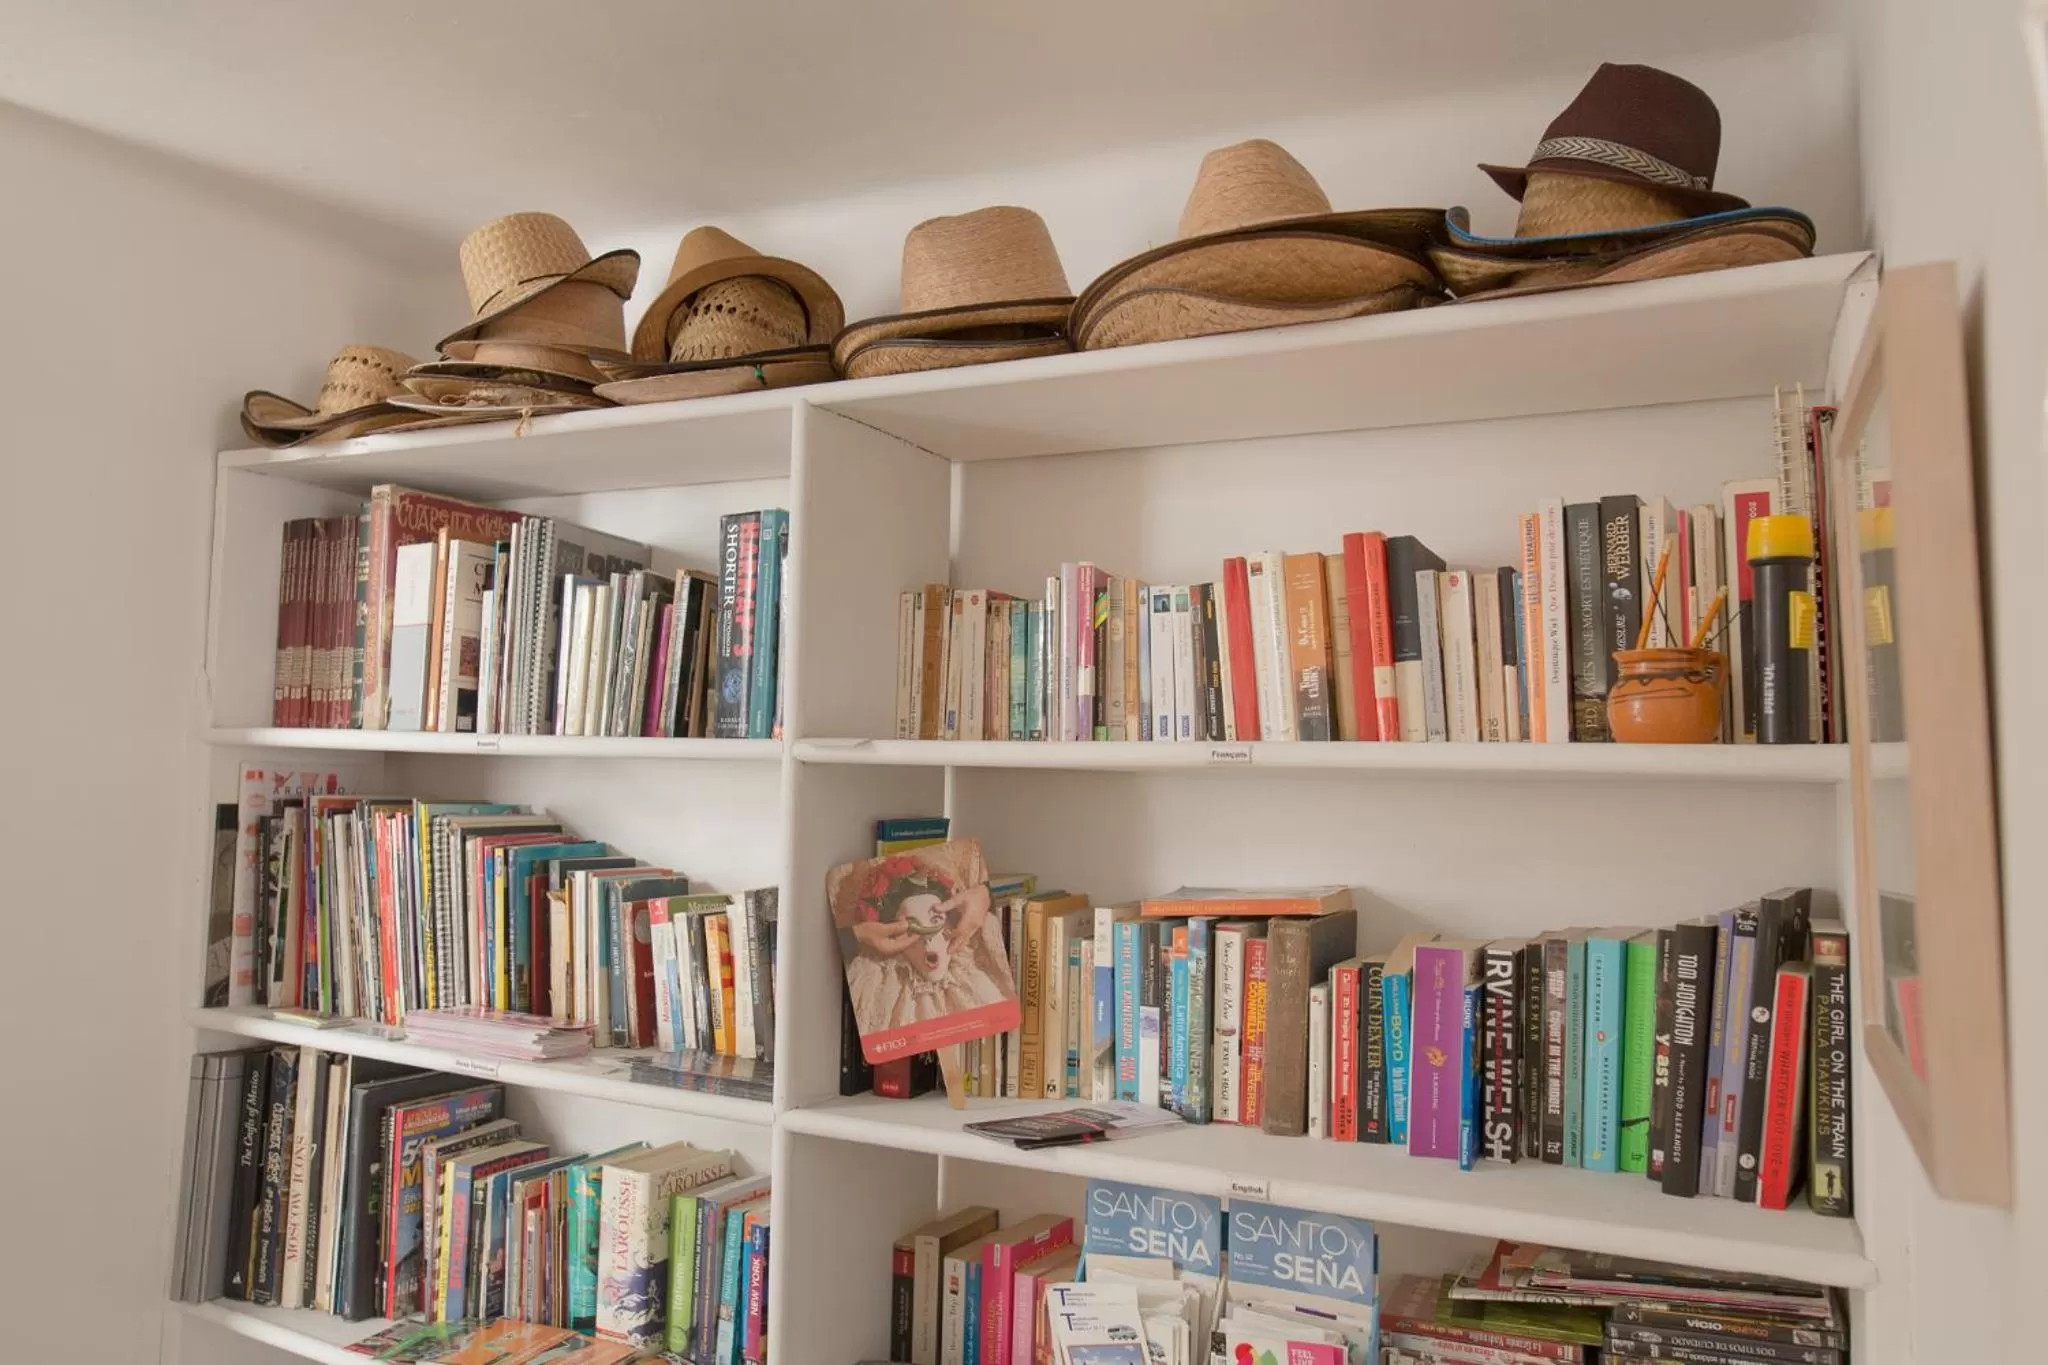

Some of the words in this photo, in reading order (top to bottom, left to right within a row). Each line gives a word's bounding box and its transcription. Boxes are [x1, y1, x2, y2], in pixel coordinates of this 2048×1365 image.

[723, 524, 737, 607] SHORTER
[1607, 522, 1617, 573] BERNARD
[1616, 514, 1630, 581] WERBER
[1581, 593, 1593, 628] MORT
[1582, 629, 1594, 656] UNE
[1583, 662, 1599, 701] JAMES
[1027, 939, 1039, 1008] FACUNDO
[1678, 954, 1697, 979] TOM
[1257, 981, 1267, 1034] MICHAEL
[1368, 967, 1382, 1011] COLIN
[1485, 949, 1513, 1051] IRVINE
[1531, 967, 1539, 1041] BLUESMAN
[1831, 974, 1844, 1004] THE
[1176, 1005, 1185, 1031] Latin
[1247, 981, 1257, 1042] CONNELLY
[1674, 983, 1696, 1046] HOUGHTON
[1817, 995, 1830, 1047] PAULA
[1831, 1009, 1845, 1042] GIRL
[1176, 1034, 1185, 1078] America
[1367, 1014, 1382, 1069] DEXTER
[1391, 1015, 1403, 1061] BOYD
[1548, 1057, 1561, 1076] THE
[1656, 1034, 1671, 1087] yeast
[1831, 1050, 1845, 1073] ON
[248, 1069, 260, 1106] Mexico
[1246, 1063, 1257, 1121] REVERSAL
[1548, 1077, 1560, 1115] MIDDLE
[1675, 1085, 1684, 1110] TODD
[1818, 1058, 1831, 1136] HAWKINS
[1831, 1078, 1845, 1108] THE
[243, 1119, 257, 1147] Crafts
[1483, 1059, 1513, 1163] WELSH
[1673, 1112, 1683, 1163] ALEXANDER
[1831, 1112, 1846, 1158] TRAIN
[241, 1149, 252, 1168] The
[292, 1135, 306, 1184] ICONS
[657, 1164, 726, 1201] LAROUSSE
[1232, 1183, 1263, 1193] English
[287, 1188, 304, 1263] MOSCOW
[615, 1178, 631, 1272] LAROUSSE
[1093, 1188, 1197, 1230] SANTO
[1199, 1207, 1213, 1232] Y
[1129, 1227, 1213, 1266] SEÑA
[1235, 1212, 1348, 1257] SANTO
[1349, 1238, 1365, 1260] Y
[751, 1257, 761, 1288] YORK
[1273, 1252, 1365, 1296] SEÑA
[750, 1290, 760, 1316] NEW
[1671, 1336, 1715, 1350] CUIDADO
[1727, 1343, 1755, 1354] TIPOS
[1756, 1347, 1776, 1357] DOS
